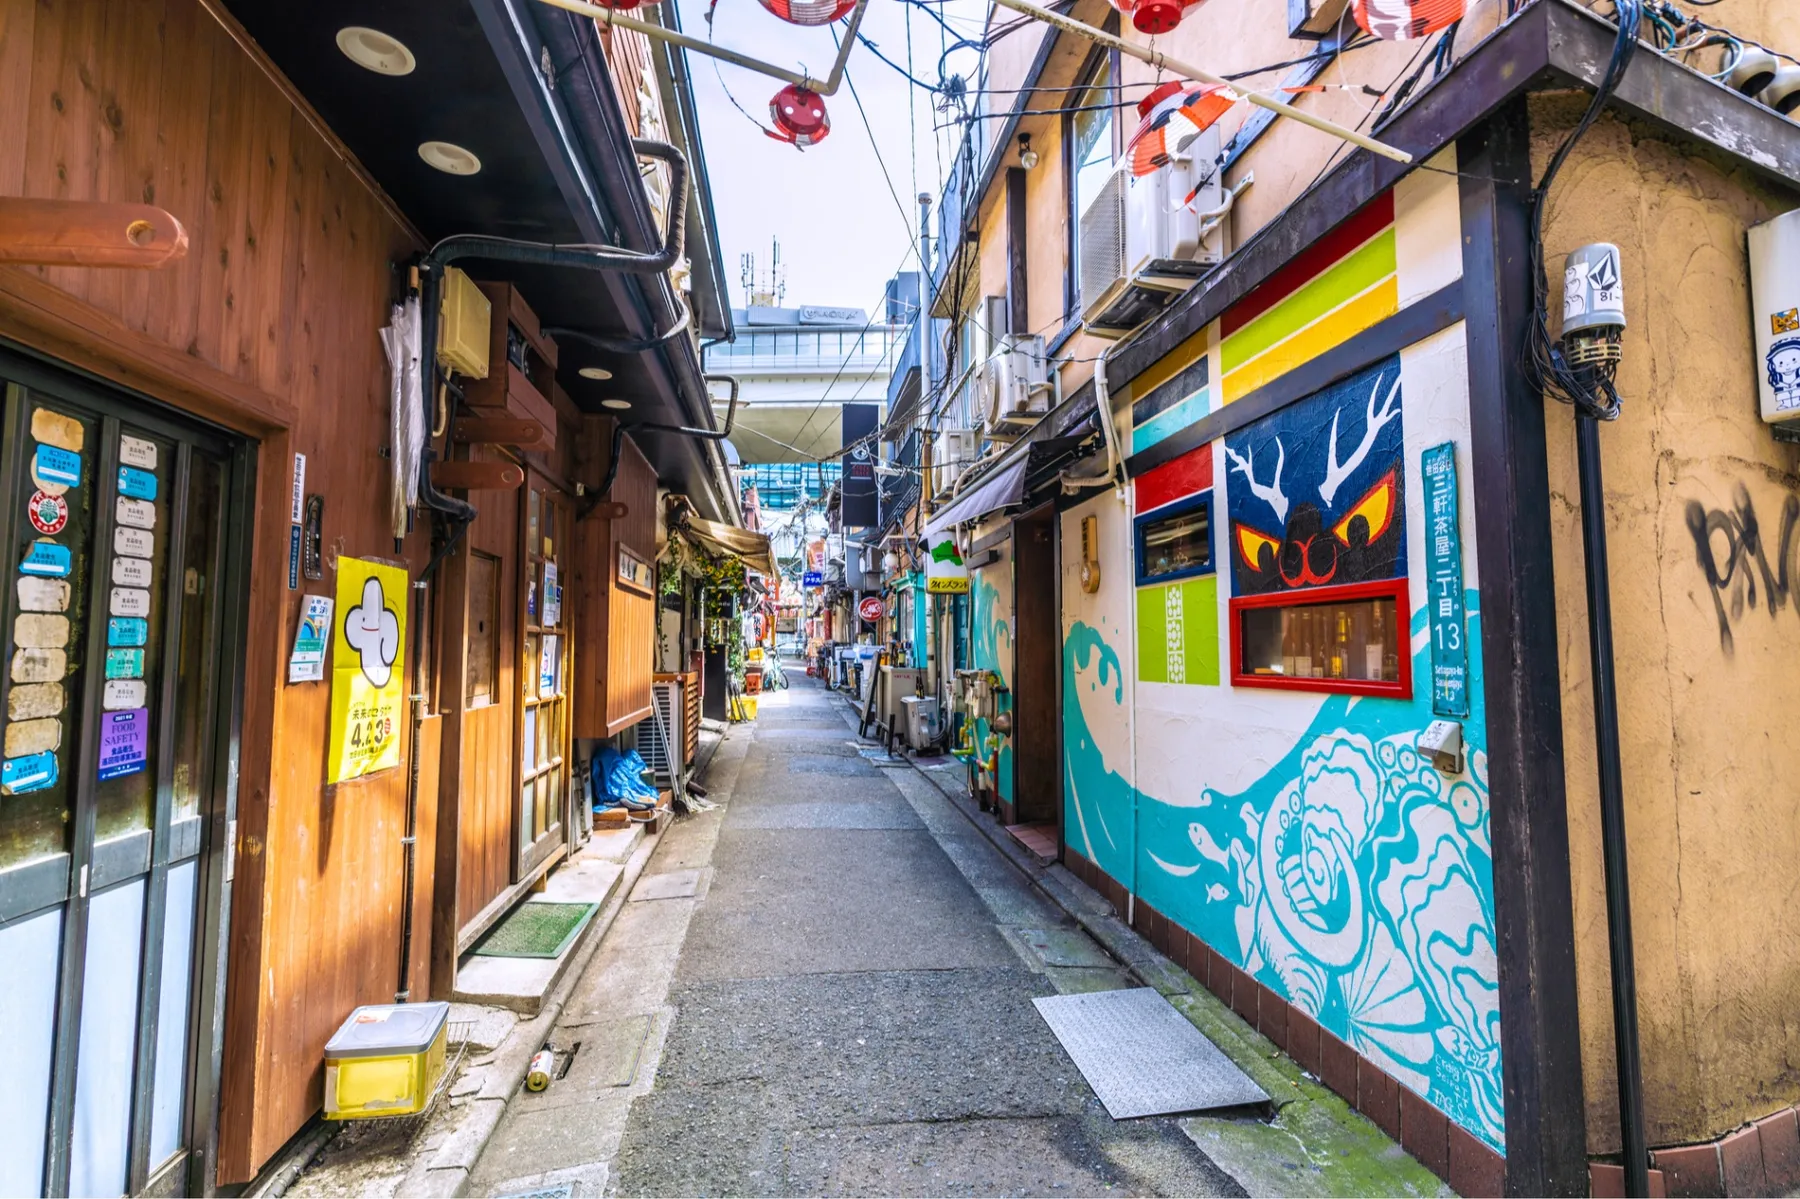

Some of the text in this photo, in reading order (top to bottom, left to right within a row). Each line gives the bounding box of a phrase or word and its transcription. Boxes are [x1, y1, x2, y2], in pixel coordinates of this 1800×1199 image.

[1435, 622, 1460, 650] 13
[111, 722, 136, 734] FOOD
[104, 731, 141, 746] SAFETY
